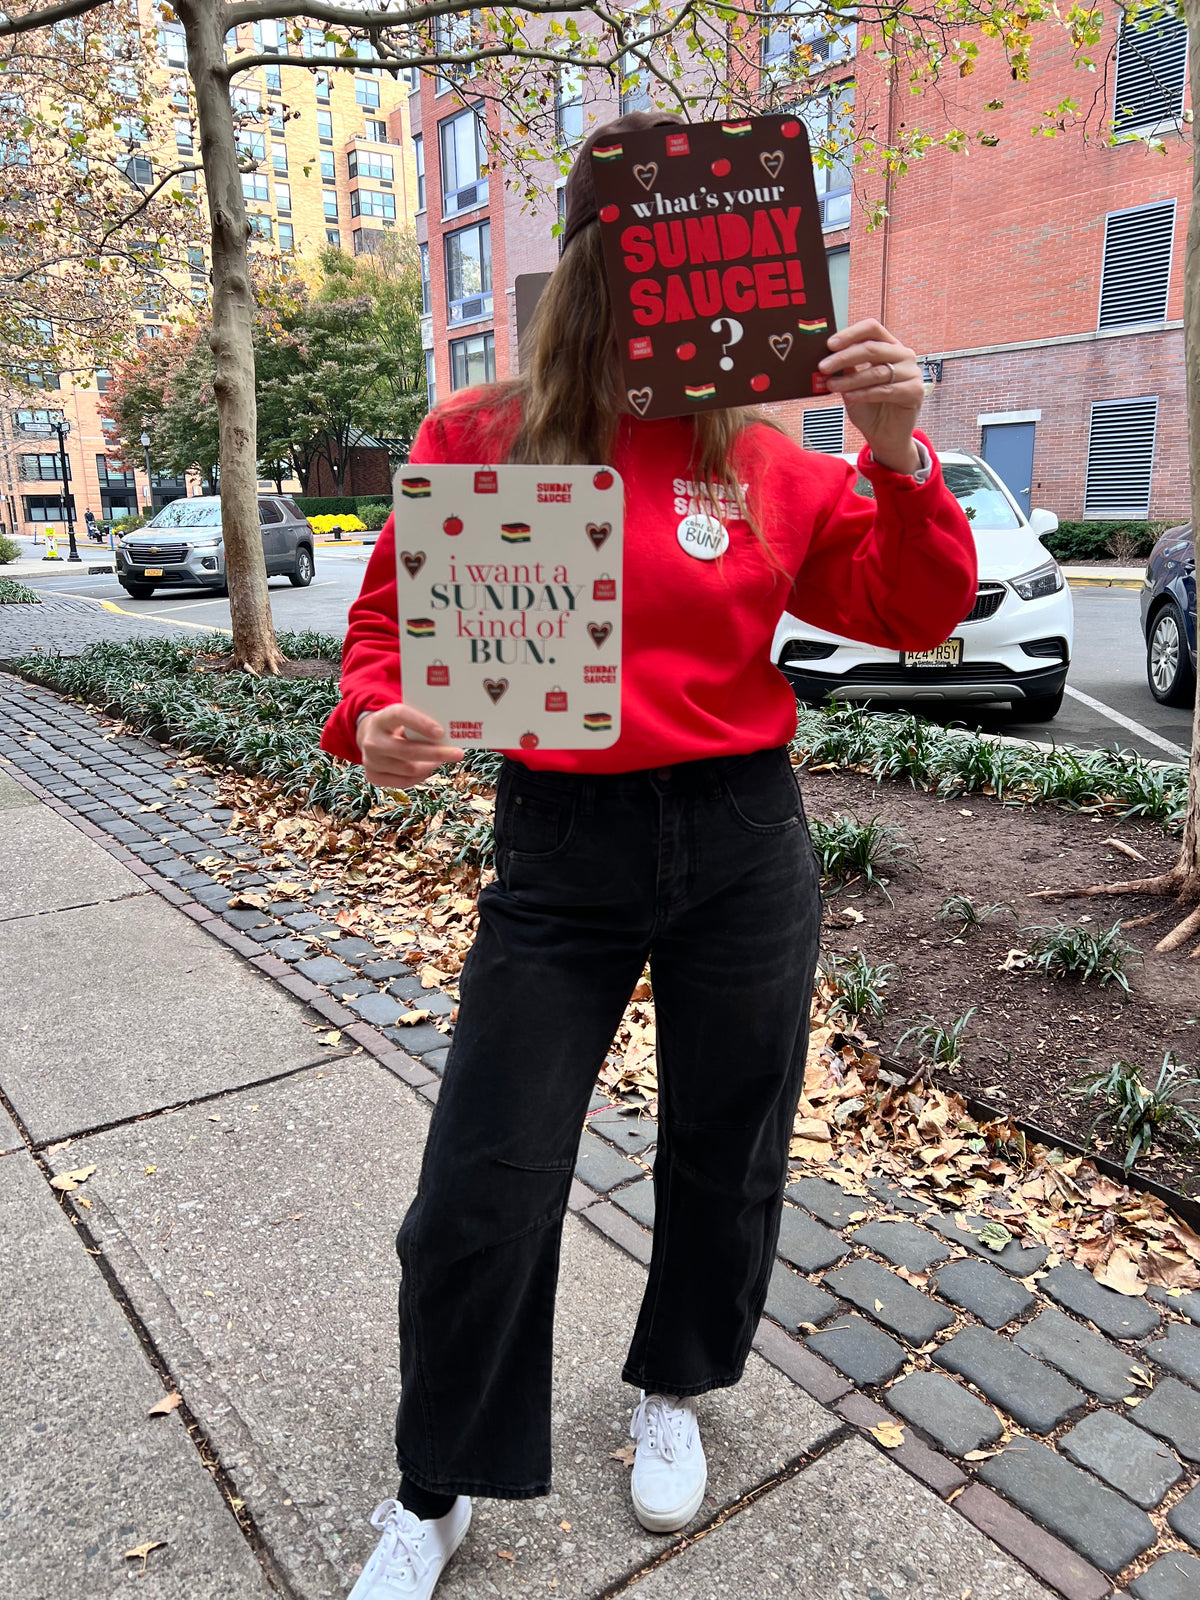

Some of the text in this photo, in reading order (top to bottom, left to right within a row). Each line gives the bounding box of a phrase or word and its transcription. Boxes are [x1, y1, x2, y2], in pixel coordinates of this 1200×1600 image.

[631, 185, 785, 218] what's your
[621, 206, 802, 273] SUNDAY
[629, 259, 807, 326] SAUCE!
[710, 317, 744, 372] ?
[536, 482, 573, 493] SUNDAY
[536, 493, 572, 503] SAUCE!
[449, 555, 569, 584] i want a
[430, 583, 587, 611] SUNDAY
[456, 610, 570, 639] kind of
[469, 638, 556, 665] BUN.
[937, 646, 958, 659] RSY
[583, 665, 618, 674] SUNDAY
[583, 675, 616, 684] SAUCE!
[449, 721, 484, 729] SUNDAY
[449, 730, 482, 739] SAUCE!
